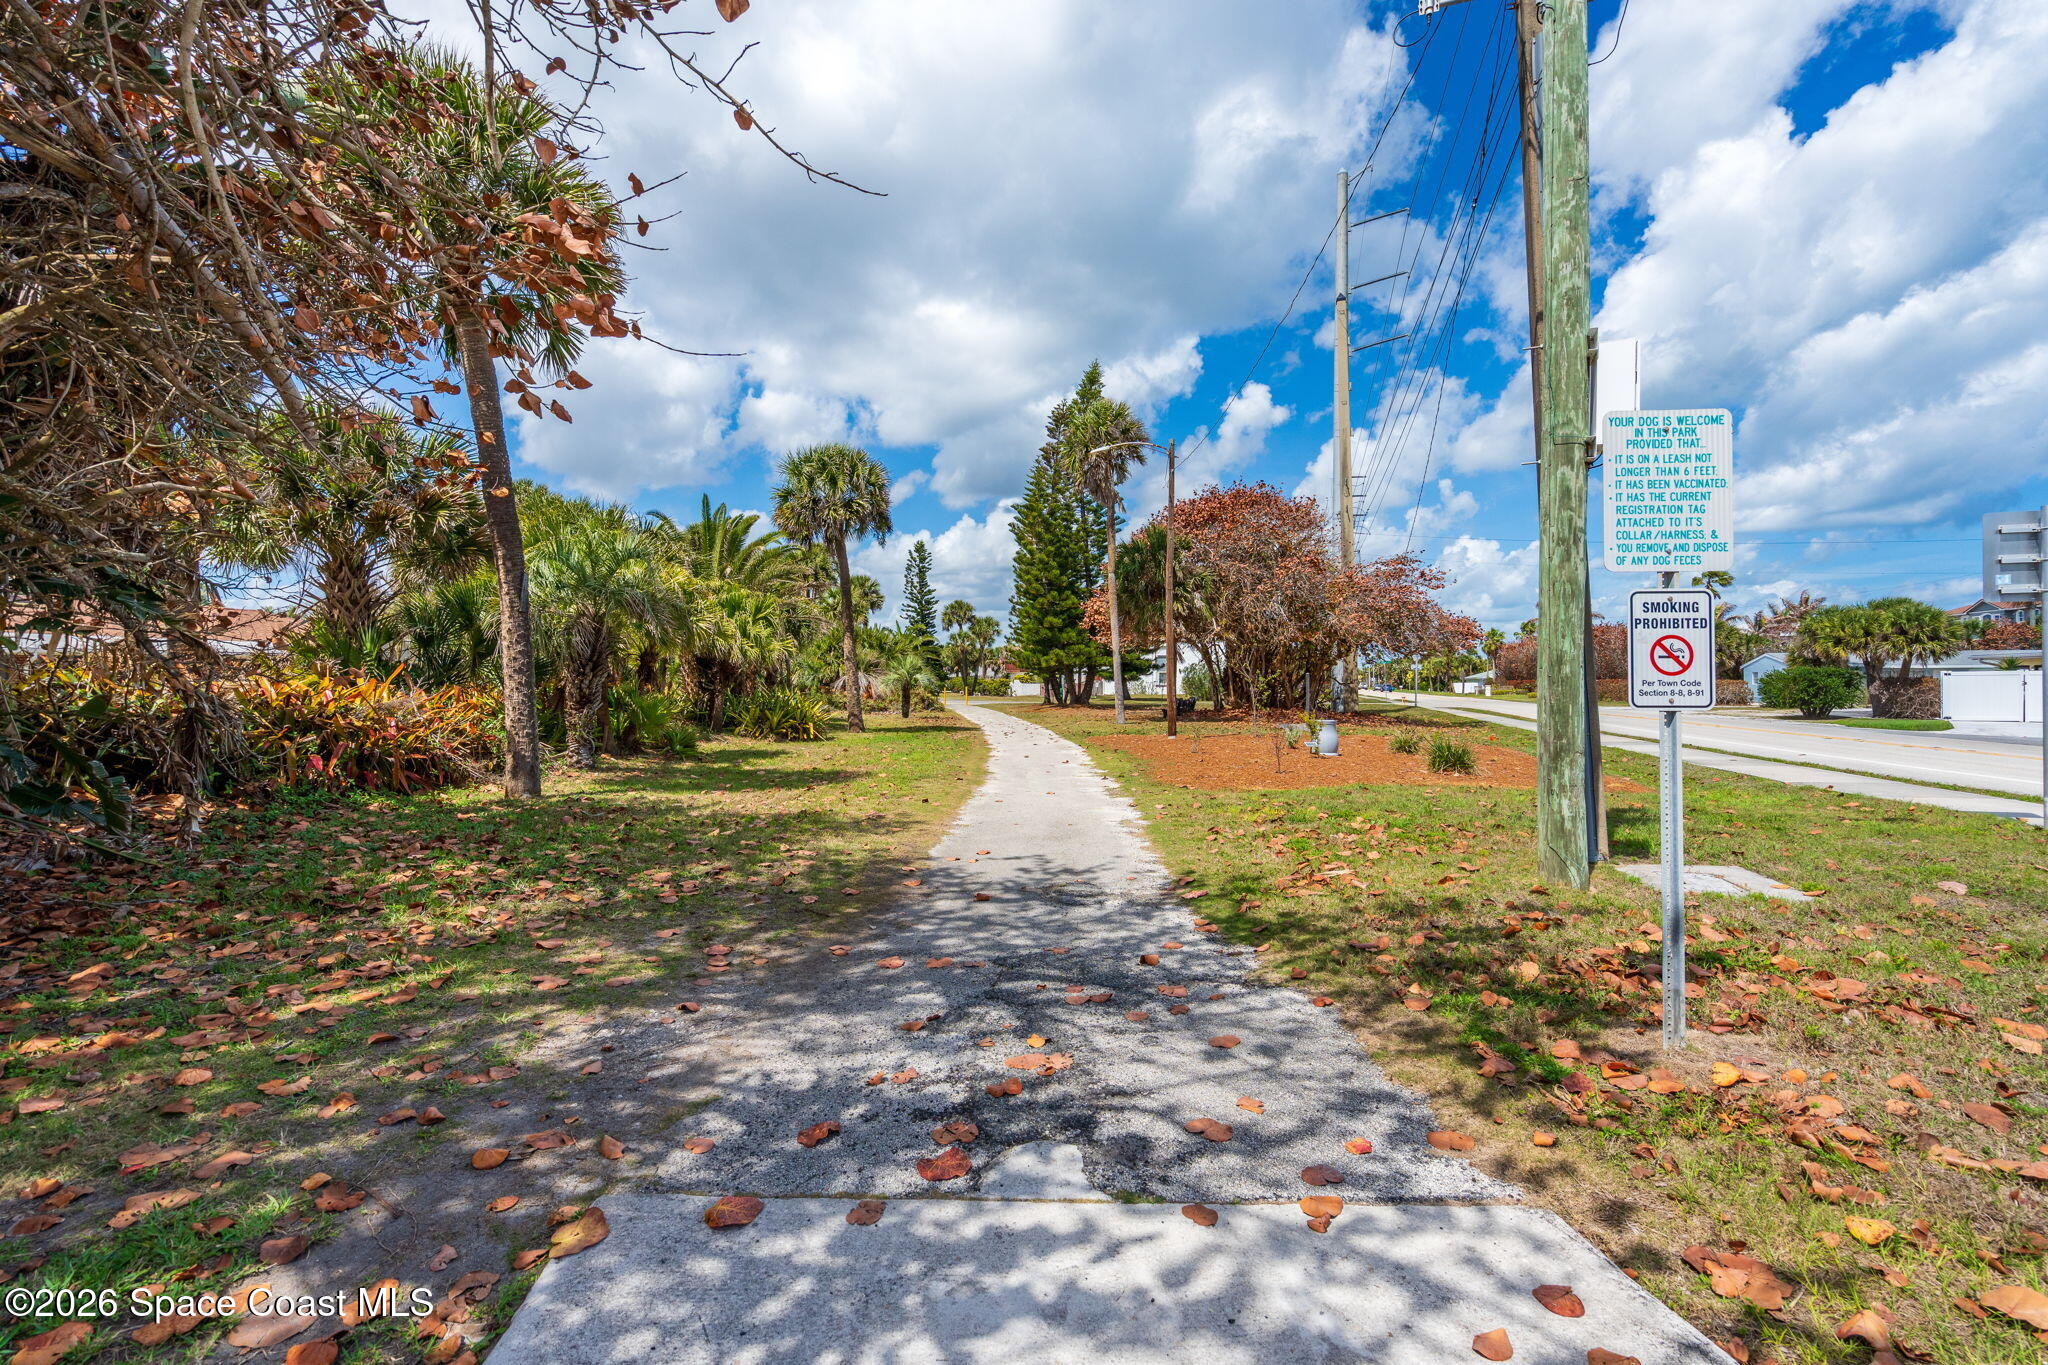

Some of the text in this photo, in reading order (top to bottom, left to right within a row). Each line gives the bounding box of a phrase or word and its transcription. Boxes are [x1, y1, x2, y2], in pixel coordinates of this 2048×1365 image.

[1609, 415, 1724, 427] YOUR DOG IS WELCOME
[1635, 427, 1697, 437] IN THIS PARK
[1626, 439, 1672, 449] PROVIDED
[1615, 453, 1712, 464] IT IS ON A LEASH NOT
[1616, 468, 1650, 476] LONGER
[1655, 467, 1679, 476] THAN
[1684, 467, 1689, 476] 6
[1615, 480, 1622, 489] IT
[1626, 480, 1643, 489] HAS
[1648, 480, 1670, 489] BEEN
[1616, 492, 1711, 502] IT HAS THE CURRENT
[1616, 504, 1706, 514] REGISTRATION TAG
[1616, 517, 1702, 527] ATTACHED TO IT'S
[1711, 530, 1718, 539] &
[1617, 542, 1728, 552] YOU REMOVE AND DISPOSE
[1616, 556, 1702, 566] OF ANY DOG FECES
[1642, 602, 1699, 613] SMOKING
[1635, 618, 1707, 629] PROHIBITED
